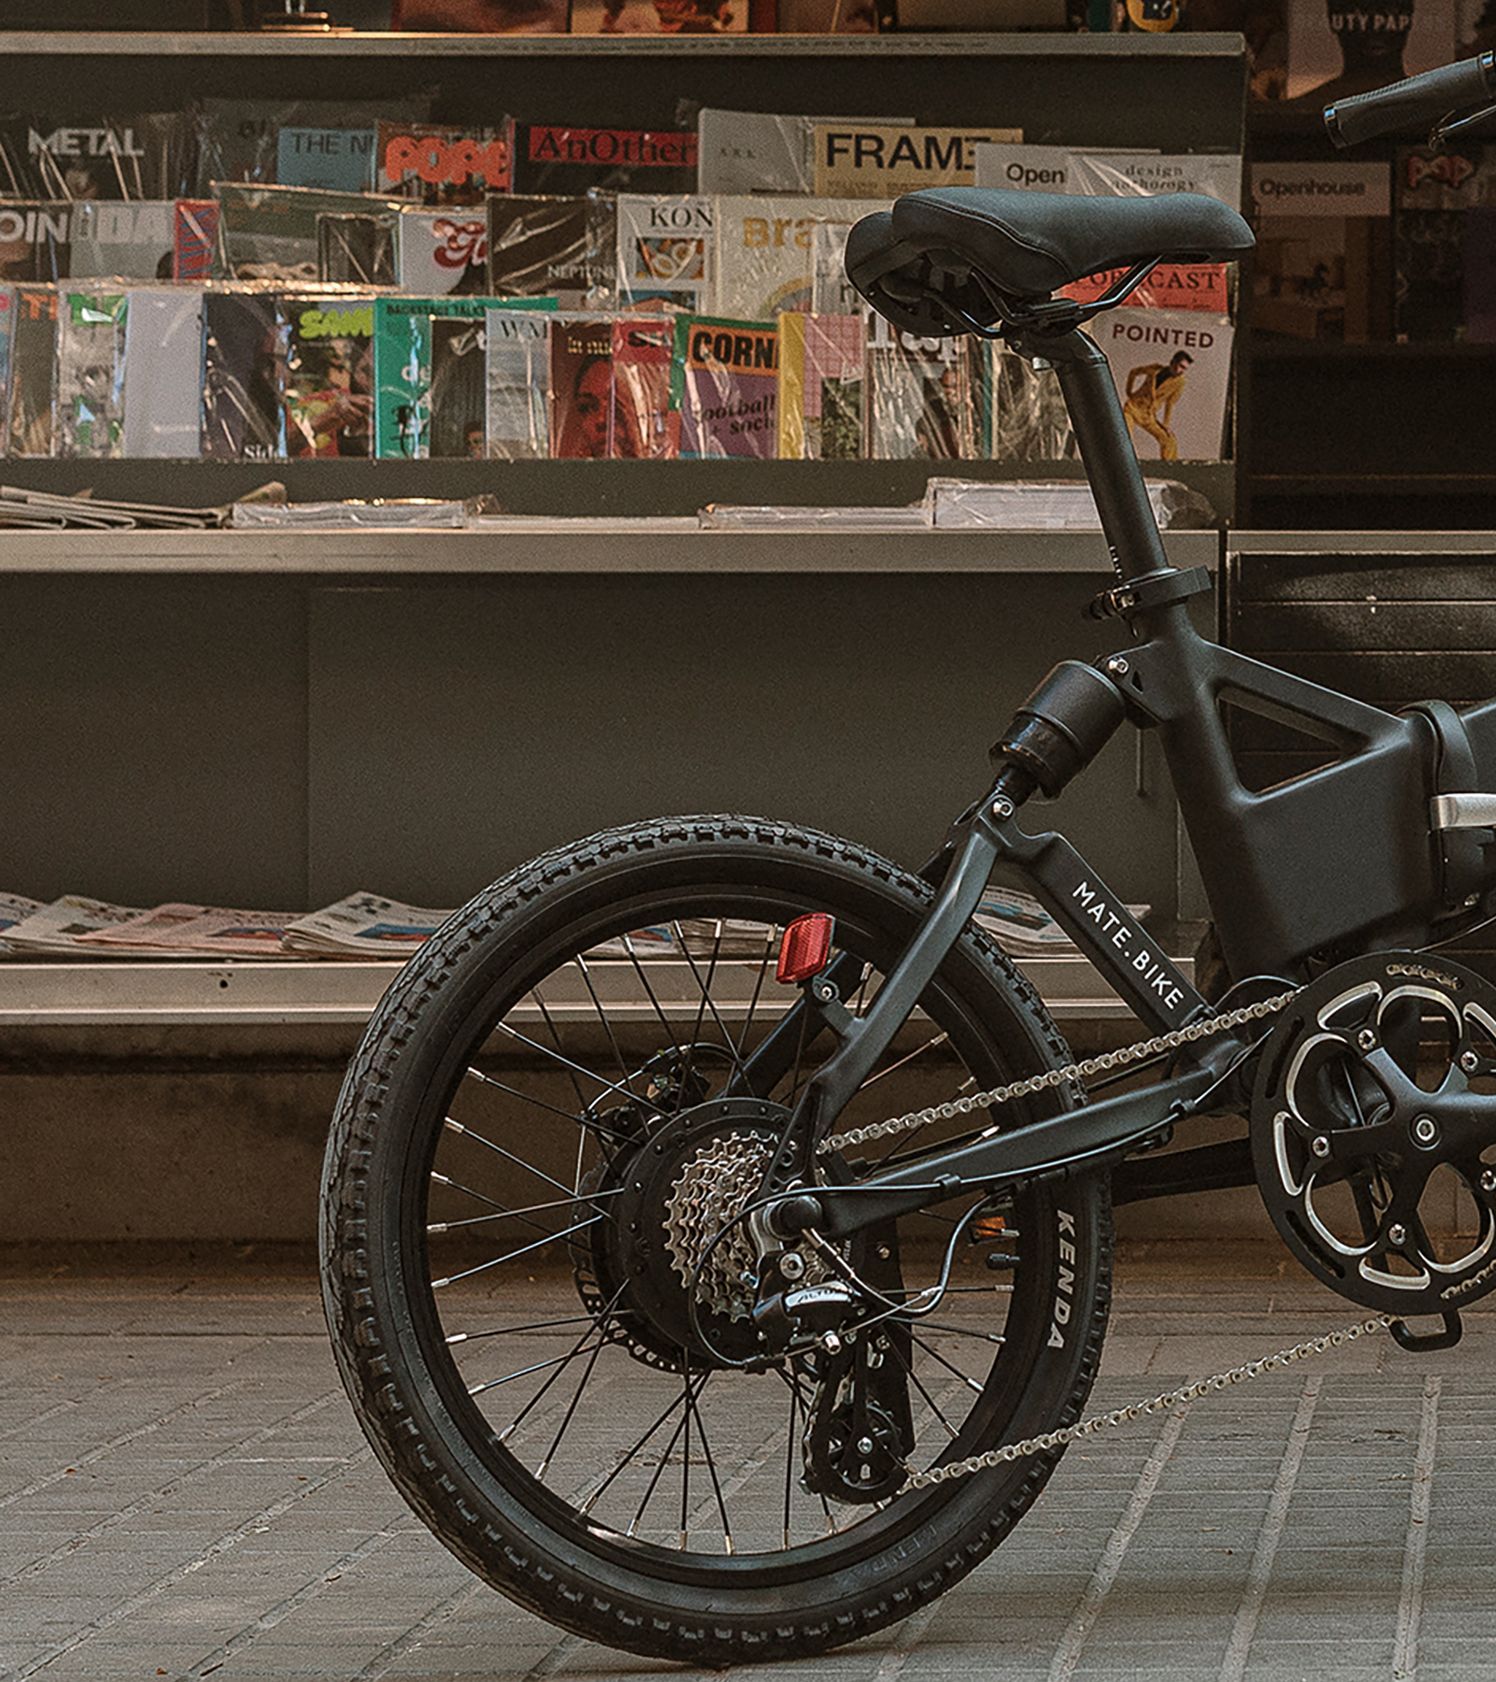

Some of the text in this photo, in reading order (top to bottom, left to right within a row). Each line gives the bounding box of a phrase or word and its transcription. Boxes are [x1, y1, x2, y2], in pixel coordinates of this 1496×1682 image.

[29, 128, 145, 157] METAL
[291, 132, 342, 154] THE
[534, 131, 694, 165] AnOther
[1125, 165, 1182, 177] design
[1260, 179, 1366, 198] Openhouse
[692, 331, 779, 369] CORN
[1112, 323, 1214, 349] POINTED
[1072, 881, 1185, 1011] MATE.BIKE
[1047, 1207, 1079, 1349] KENDA
